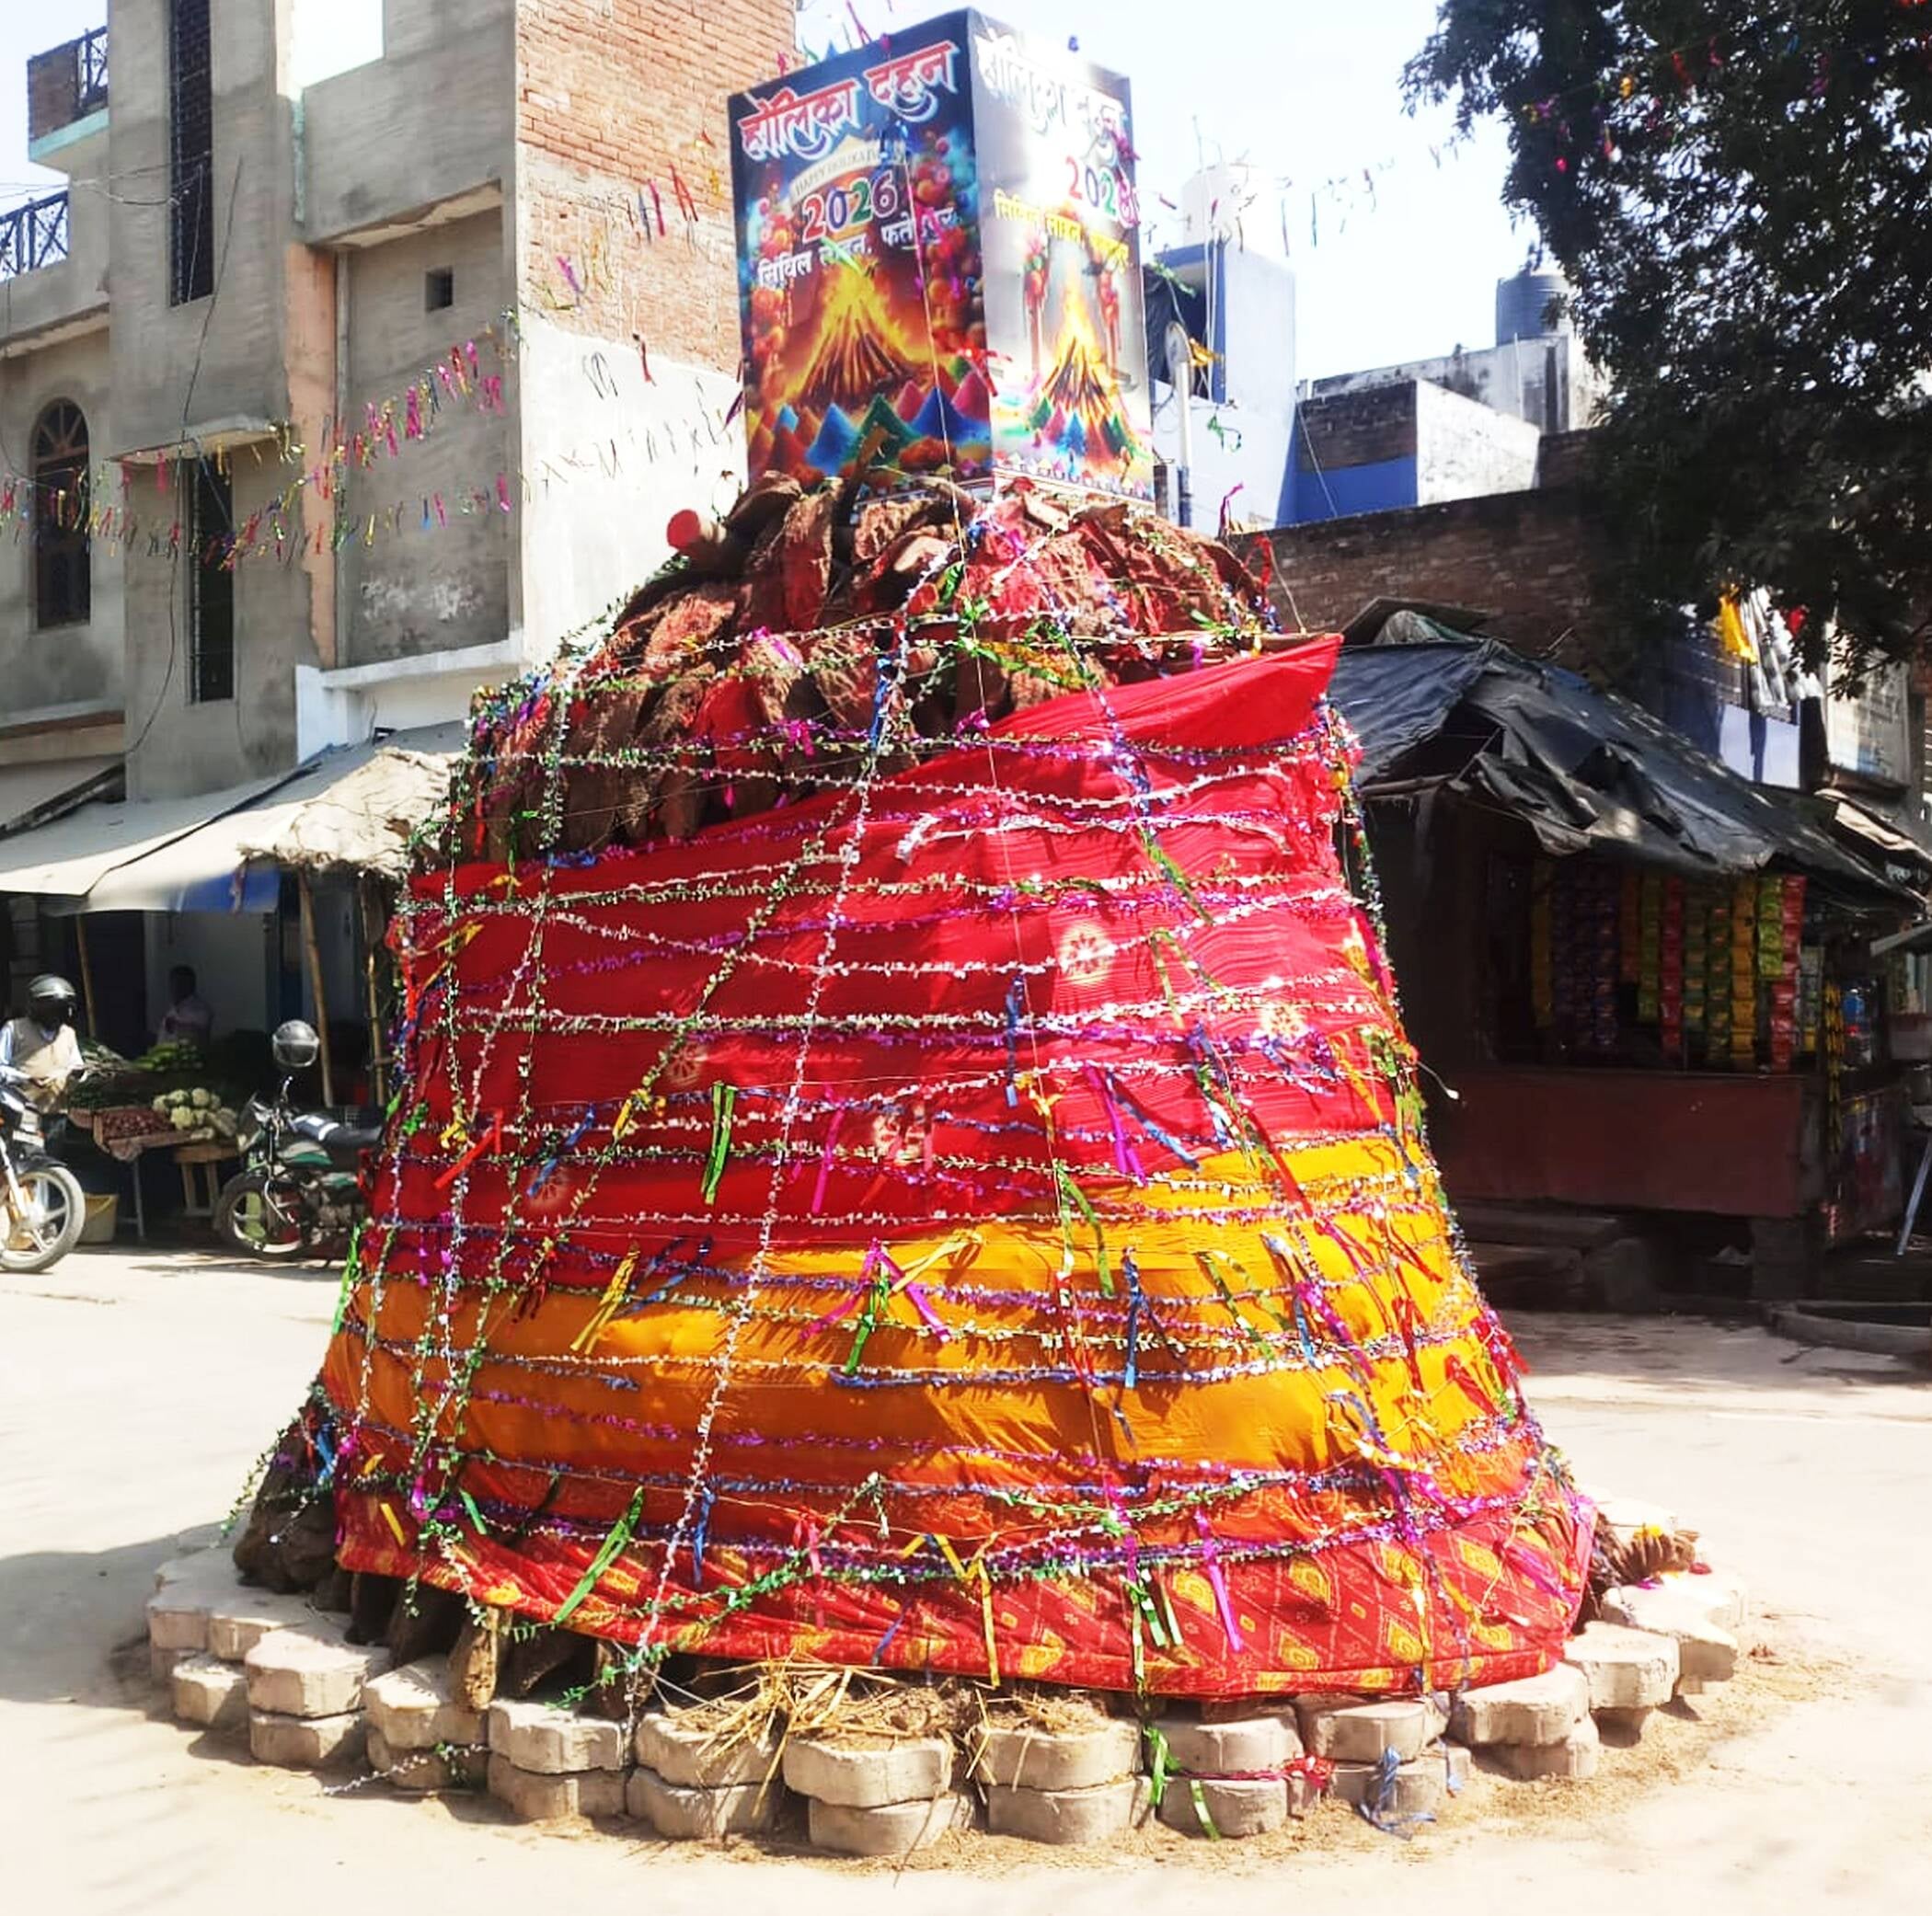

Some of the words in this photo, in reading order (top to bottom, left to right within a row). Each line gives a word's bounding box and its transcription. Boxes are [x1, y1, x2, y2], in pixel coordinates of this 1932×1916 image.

[738, 77, 862, 162] होलिका
[863, 40, 960, 122] दहन
[801, 169, 899, 244] 2026
